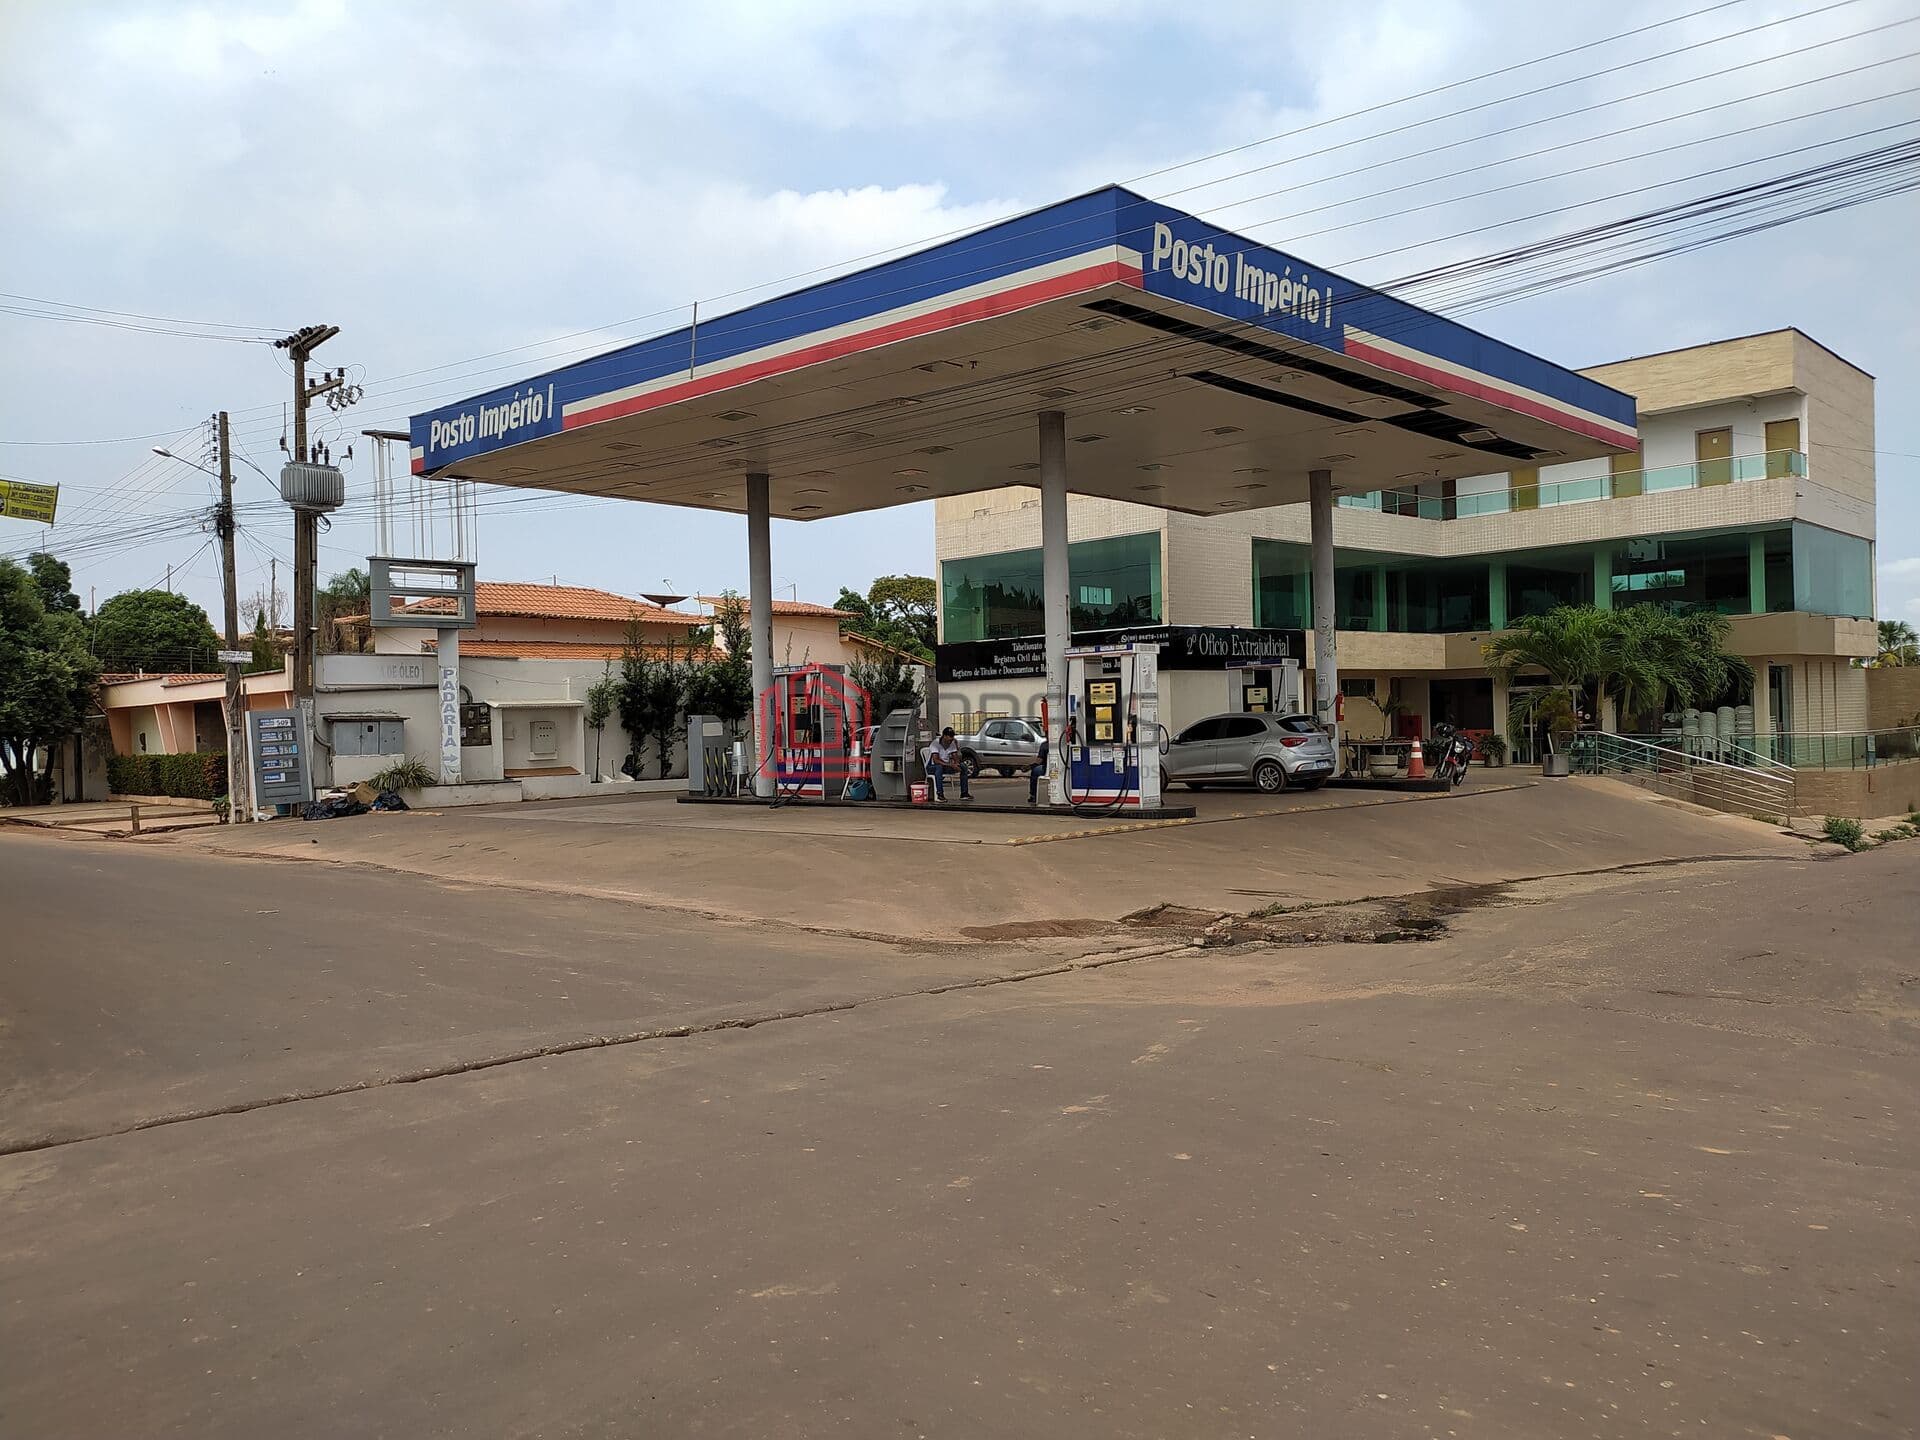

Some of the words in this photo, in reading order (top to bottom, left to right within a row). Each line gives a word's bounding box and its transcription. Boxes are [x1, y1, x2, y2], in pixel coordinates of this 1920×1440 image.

[1152, 222, 1230, 293] Posto
[1235, 252, 1321, 325] Império
[1325, 286, 1333, 329] I
[430, 411, 475, 453] Posto
[478, 387, 544, 440] Império
[547, 383, 554, 419] I
[1012, 642, 1042, 652] Tabelionato
[1231, 634, 1290, 661] Extrajudicial
[994, 655, 1016, 666] Registro
[1017, 653, 1031, 662] Civil
[1031, 653, 1041, 662] das
[400, 663, 420, 678] ÓLEO
[952, 668, 973, 679] Registro
[974, 667, 980, 676] de
[1003, 664, 1034, 675] Documentos
[443, 669, 457, 747] PADARIA
